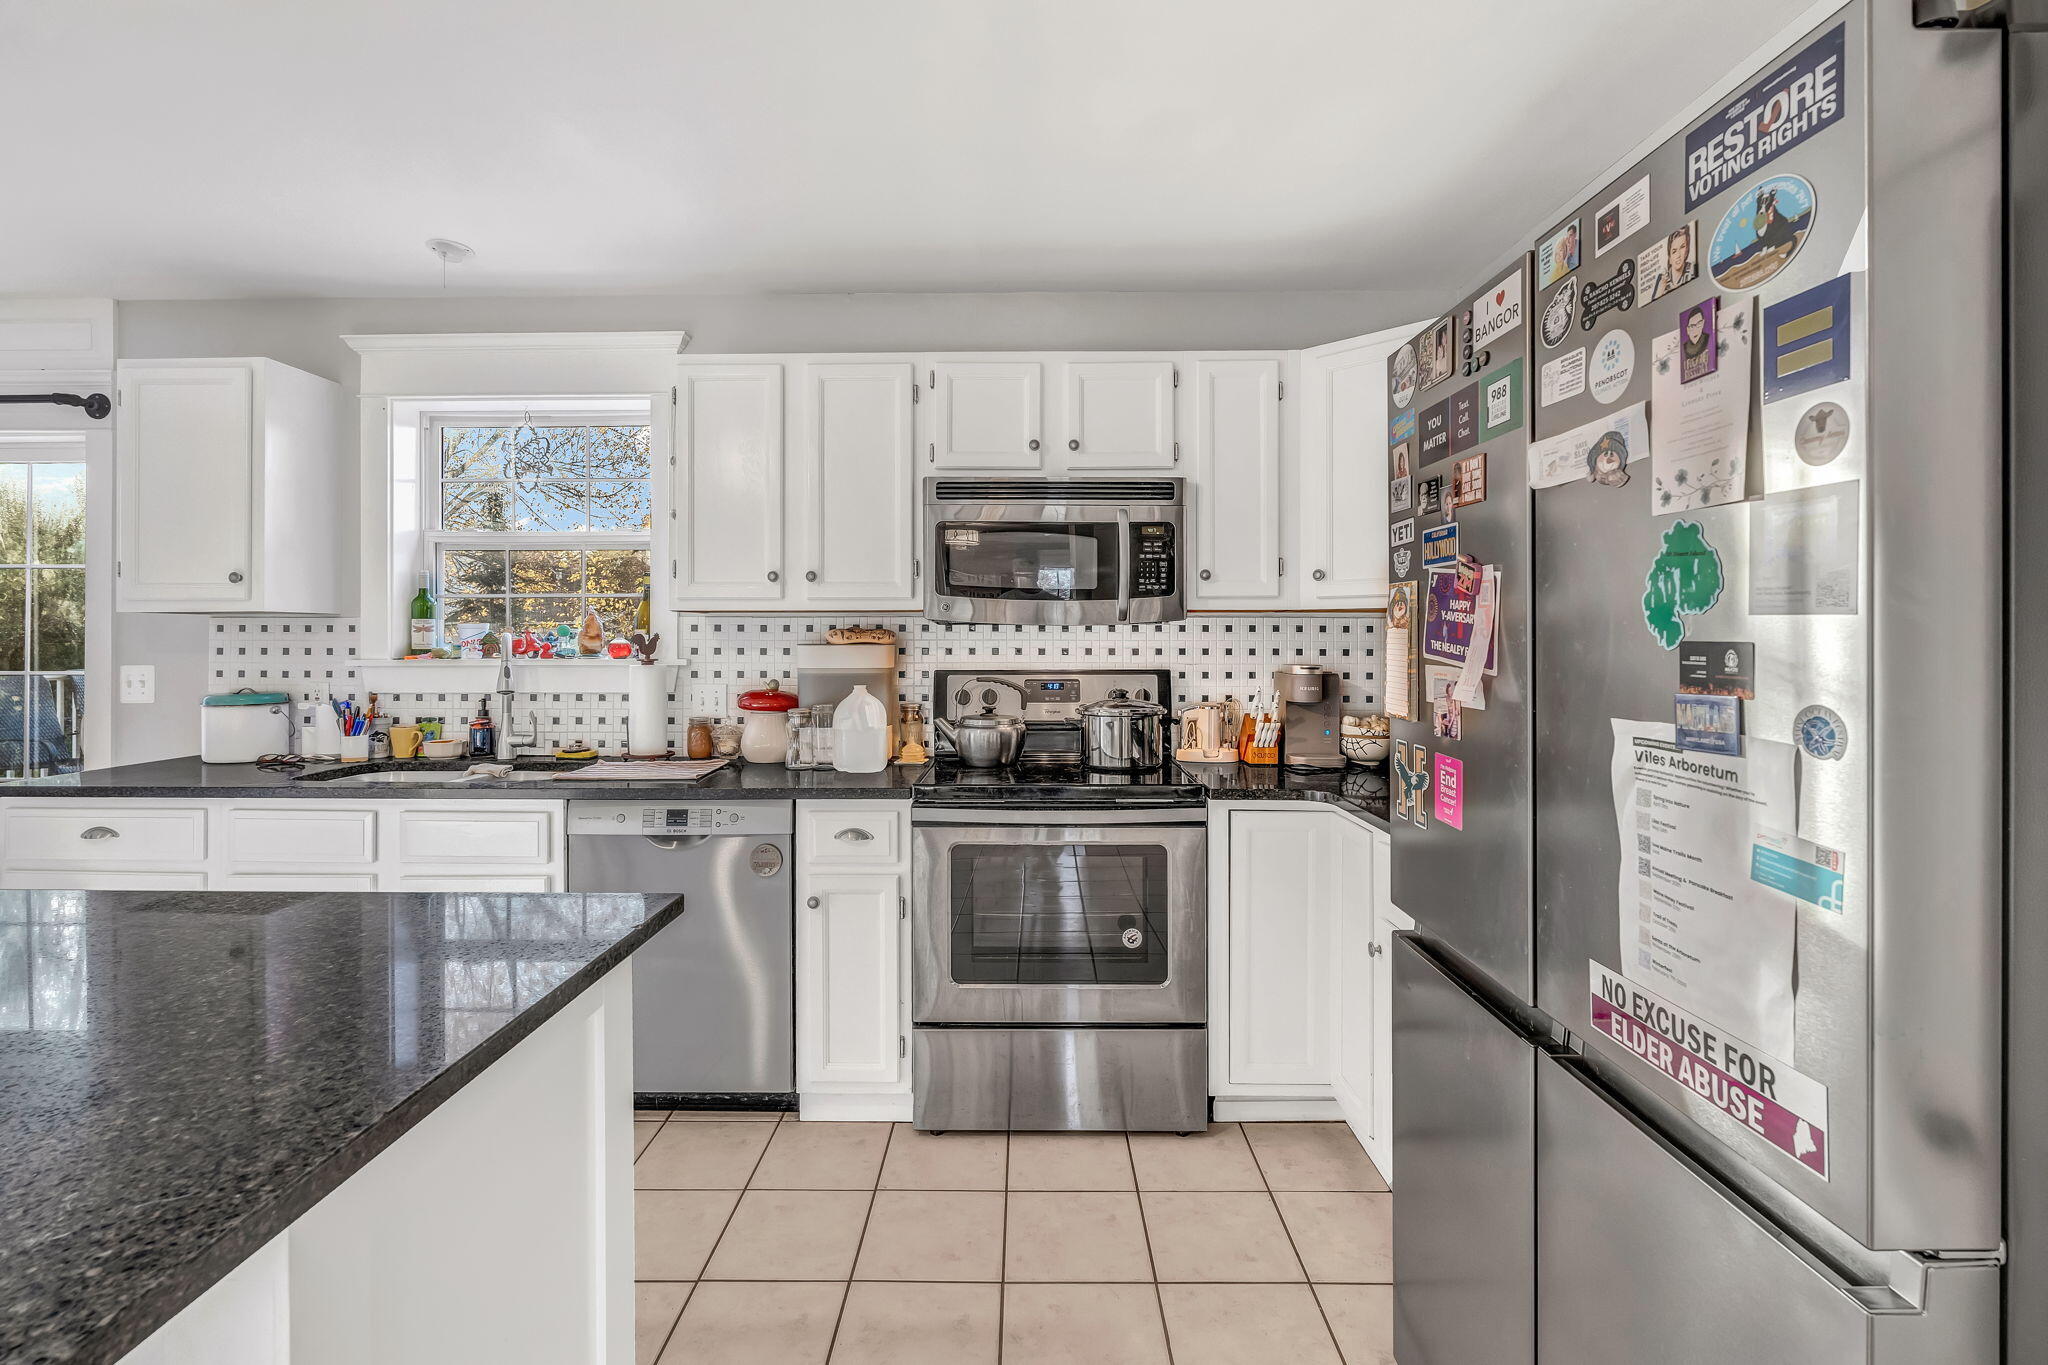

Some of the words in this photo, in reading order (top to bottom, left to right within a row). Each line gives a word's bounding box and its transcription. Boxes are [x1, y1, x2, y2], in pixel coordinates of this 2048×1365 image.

[1688, 54, 1837, 185] RESTORE
[1688, 147, 1755, 201] VOTING
[1757, 93, 1837, 160] RIGHTS
[1485, 301, 1489, 315] I
[1475, 303, 1519, 342] BANGOR
[1594, 368, 1628, 388] PENOBSCOT
[1491, 384, 1507, 403] 988
[1427, 414, 1442, 431] YOU
[1423, 432, 1447, 452] MATTER
[1424, 537, 1457, 560] HOLLYWOOD
[1449, 599, 1471, 611] HAPPY
[1431, 639, 1441, 651] THE
[1634, 750, 1666, 766] Viles
[1668, 756, 1739, 783] Arboretum
[1440, 770, 1456, 789] End
[1440, 784, 1456, 798] Breast
[1710, 887, 1733, 901] Breakfast
[1601, 973, 1627, 1010] NO
[1632, 991, 1717, 1066] EXCUSE
[1724, 1043, 1777, 1101] FOR
[1610, 1011, 1675, 1078] ELDER
[1678, 1056, 1765, 1134] ABUSE
